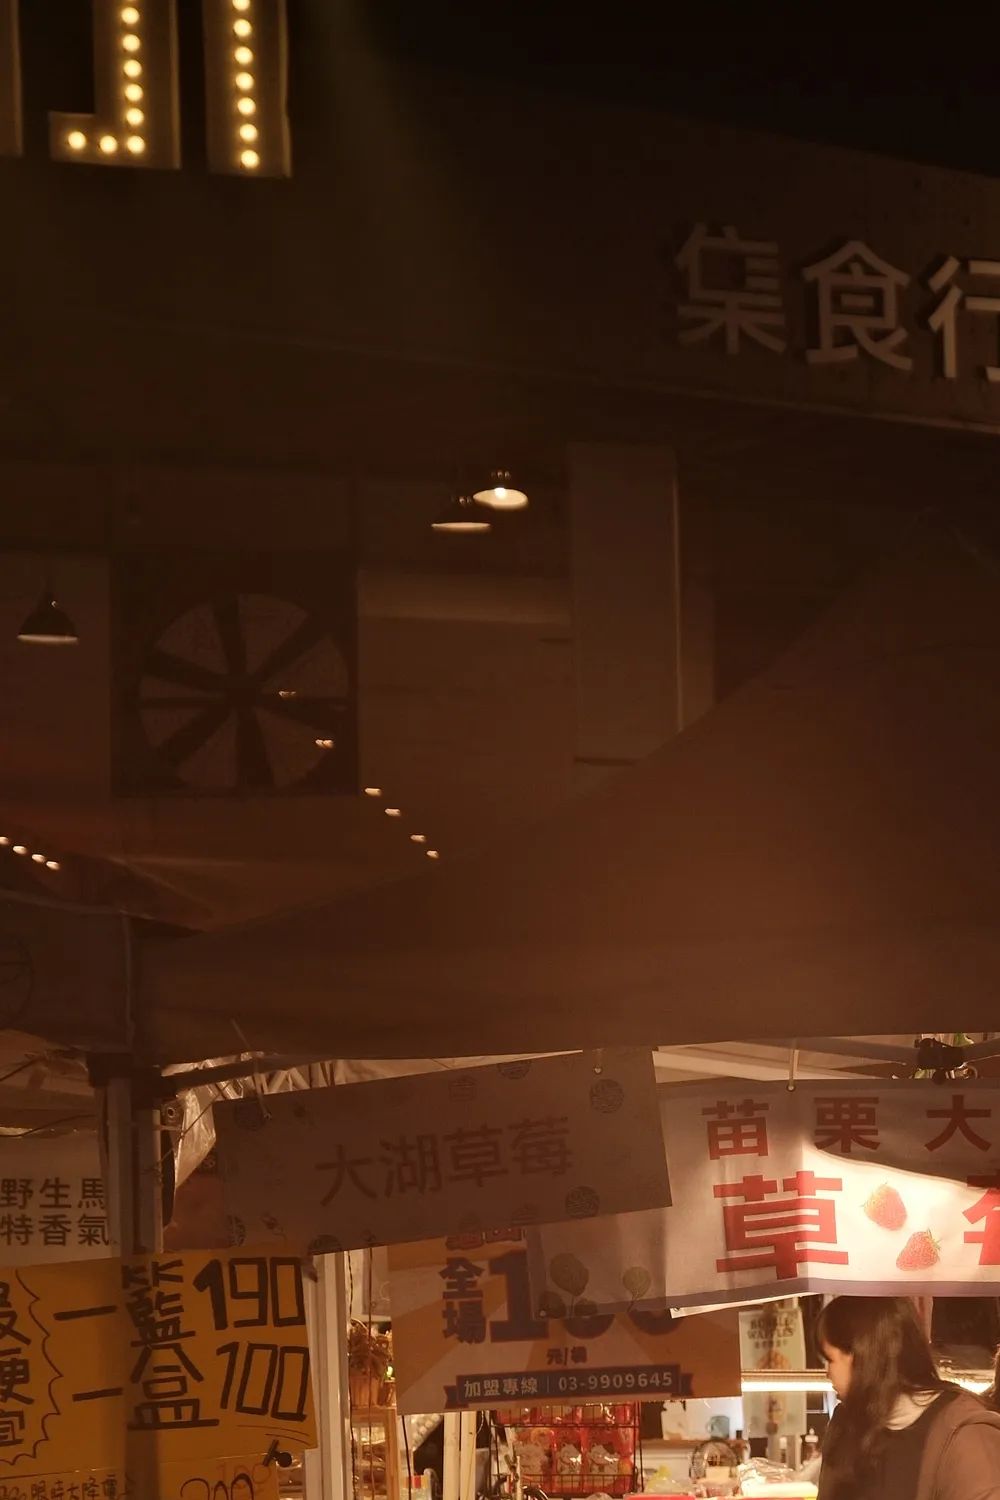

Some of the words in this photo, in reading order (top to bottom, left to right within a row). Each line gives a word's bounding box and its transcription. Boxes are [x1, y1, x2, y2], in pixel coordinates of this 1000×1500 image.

[315, 1117, 571, 1207] 大湖草莓
[0, 1213, 109, 1246] 特香氣
[193, 1257, 306, 1330] 190
[439, 1257, 486, 1344] 全場
[216, 1341, 310, 1422] 100
[464, 1377, 538, 1397] 加盟專線
[558, 1372, 673, 1391] 03-9909645
